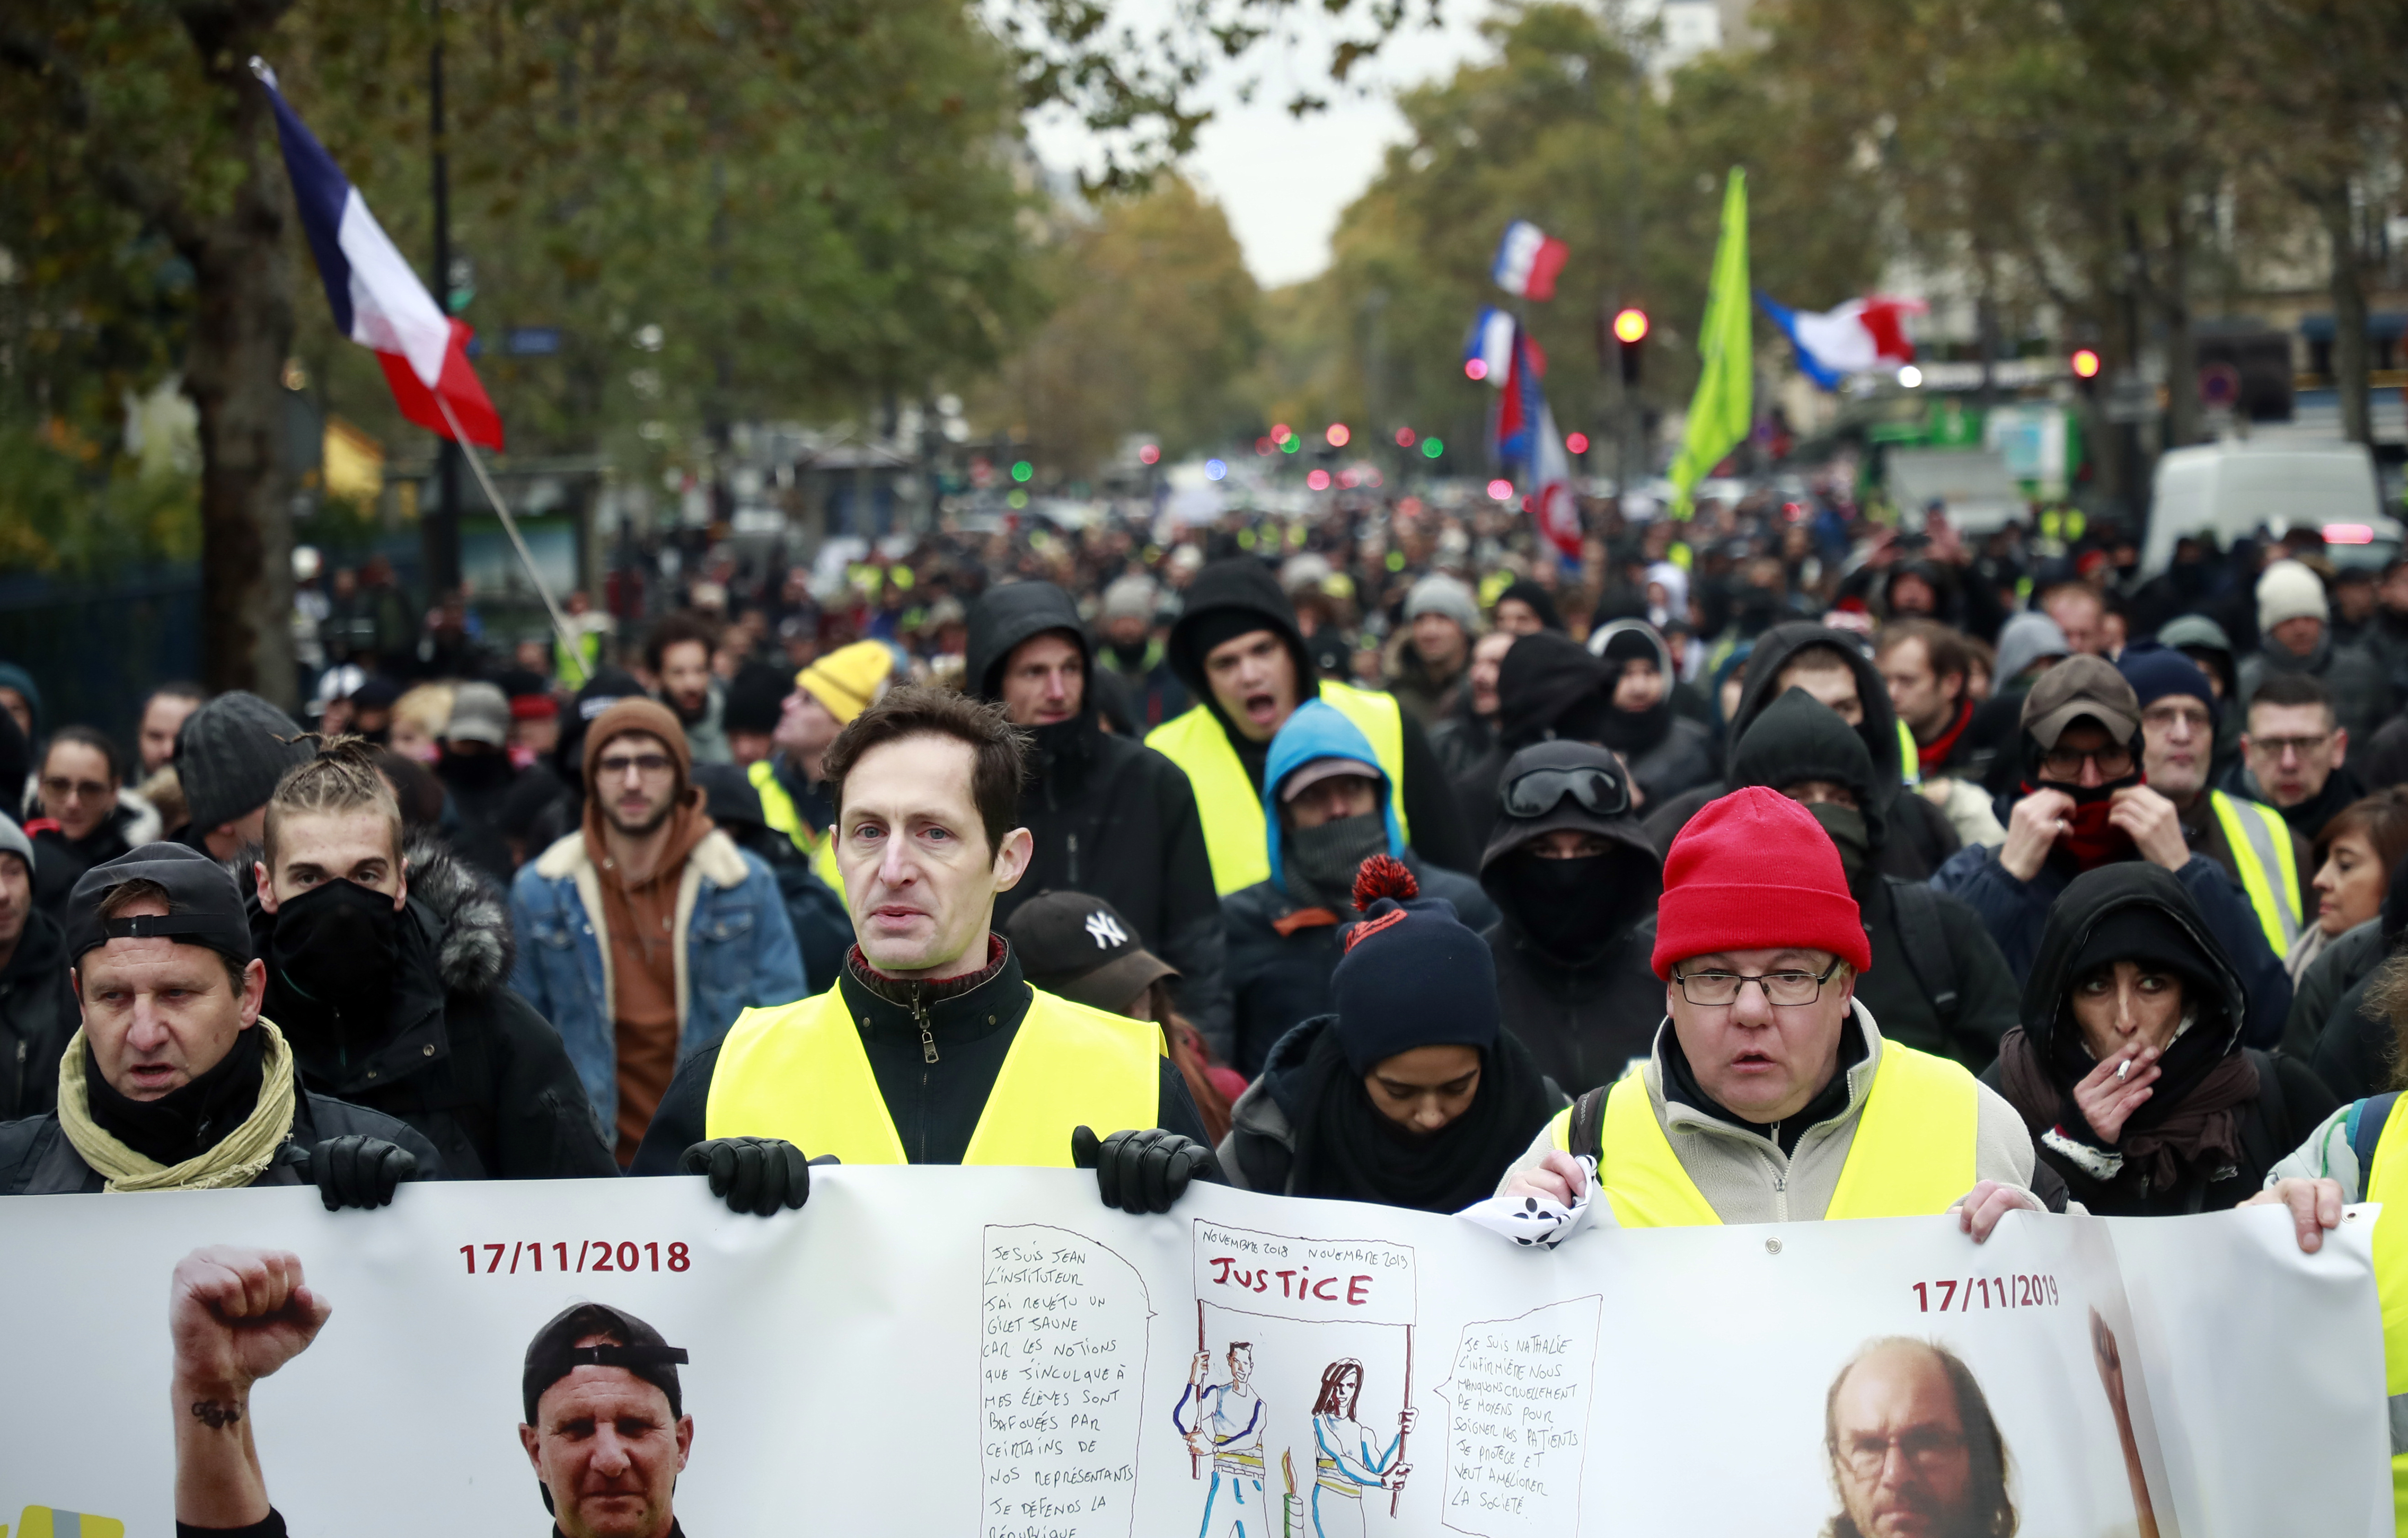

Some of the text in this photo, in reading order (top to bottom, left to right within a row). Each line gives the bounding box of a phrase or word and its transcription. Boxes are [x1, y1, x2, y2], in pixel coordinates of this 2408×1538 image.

[1203, 1229, 1288, 1258] NOVEMBRE 2018
[460, 1240, 691, 1274] 17/11/2018
[1052, 1249, 1086, 1264] JEAN
[1309, 1249, 1408, 1269] NOVEMBRE 2019
[1090, 1296, 1105, 1307] UN
[1912, 1274, 2059, 1312] 17/11/2019
[1028, 1316, 1077, 1331] JAUNE
[983, 1341, 1011, 1357] CAR
[1023, 1338, 1042, 1354] LES
[1465, 1338, 1479, 1352] JE
[1530, 1364, 1562, 1379] NOUS
[1083, 1389, 1120, 1406] SONT
[1071, 1414, 1100, 1431] PAR
[1522, 1407, 1553, 1426] POUR
[1078, 1440, 1097, 1452] DE
[1456, 1439, 1471, 1456] JE
[991, 1467, 1020, 1484] NOS
[1455, 1463, 1482, 1482] VEUT
[1452, 1486, 1469, 1506] LA
[990, 1498, 1012, 1515] JE
[1091, 1496, 1106, 1512] LA
